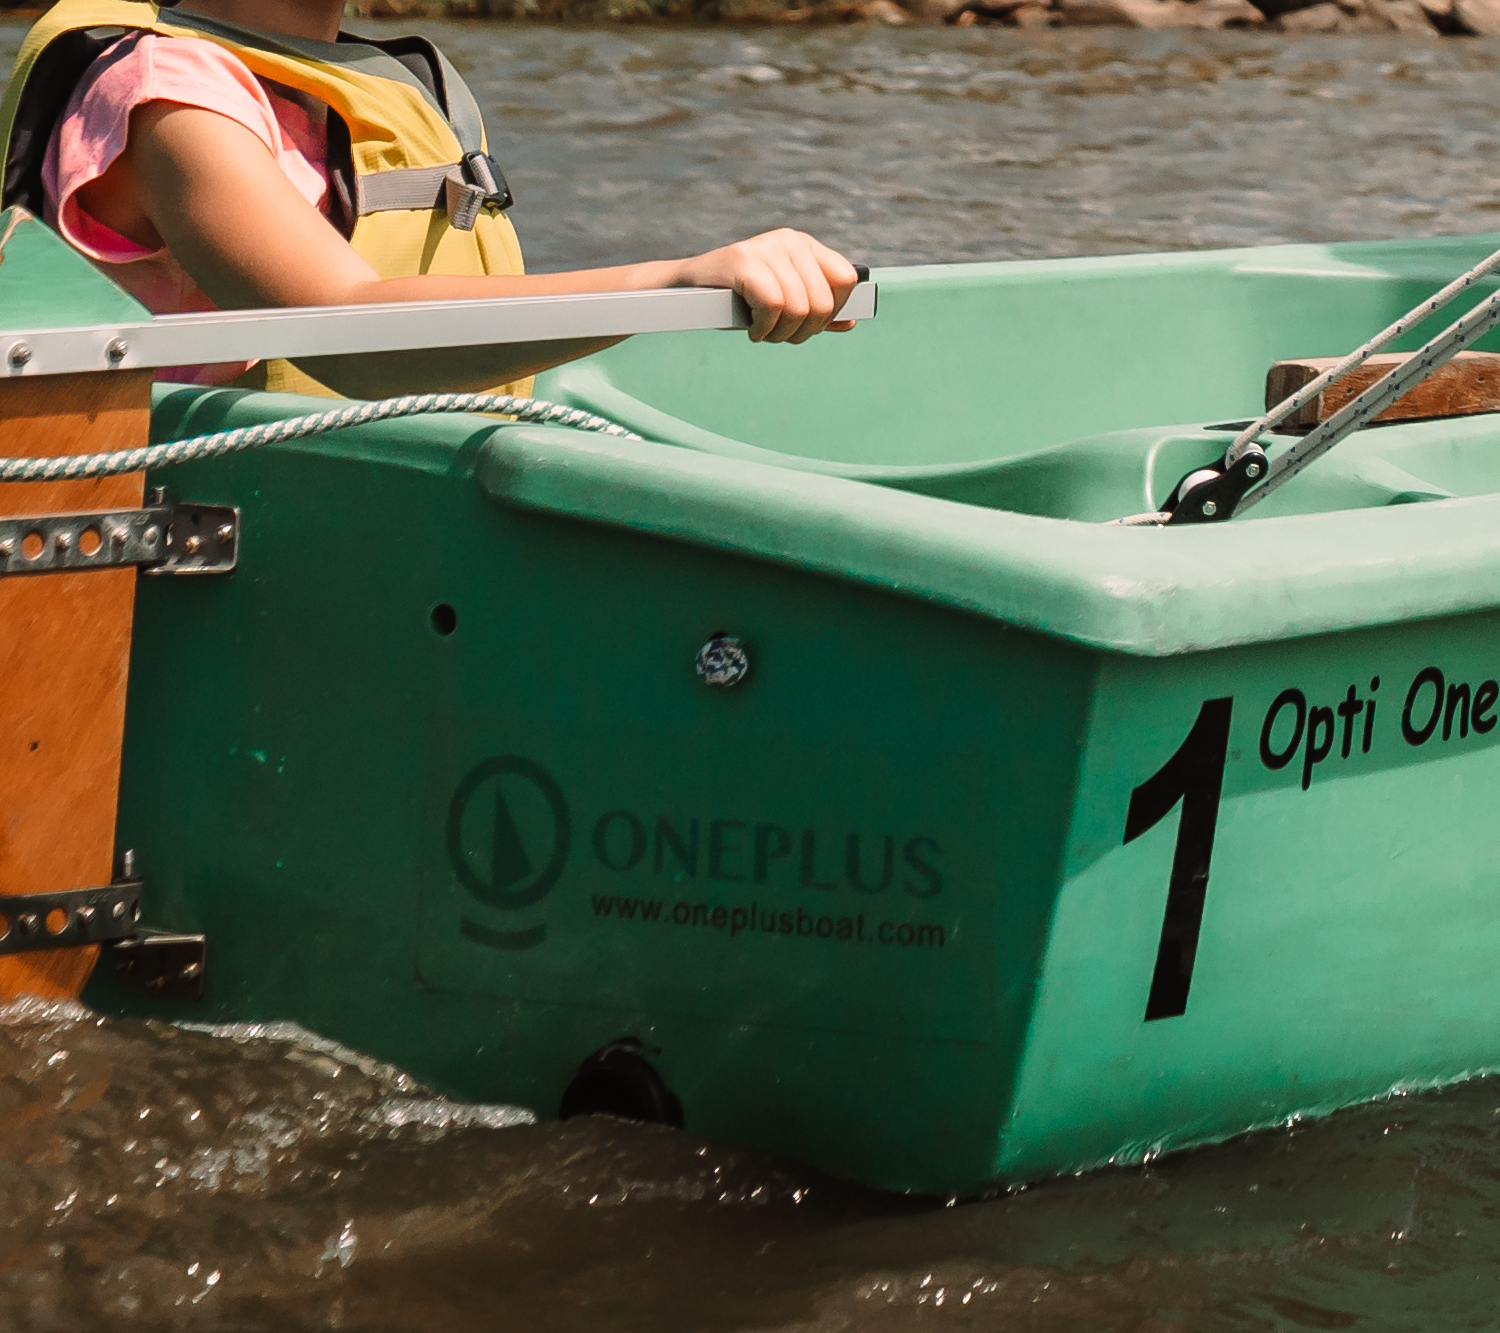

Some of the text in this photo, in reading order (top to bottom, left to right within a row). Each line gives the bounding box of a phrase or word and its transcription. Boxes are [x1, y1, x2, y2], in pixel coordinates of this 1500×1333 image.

[1258, 666, 1500, 792] Opti One
[590, 808, 947, 901] ONEPLUS
[1122, 695, 1234, 1023] 1
[590, 893, 947, 949] www.oneplusboat.com
